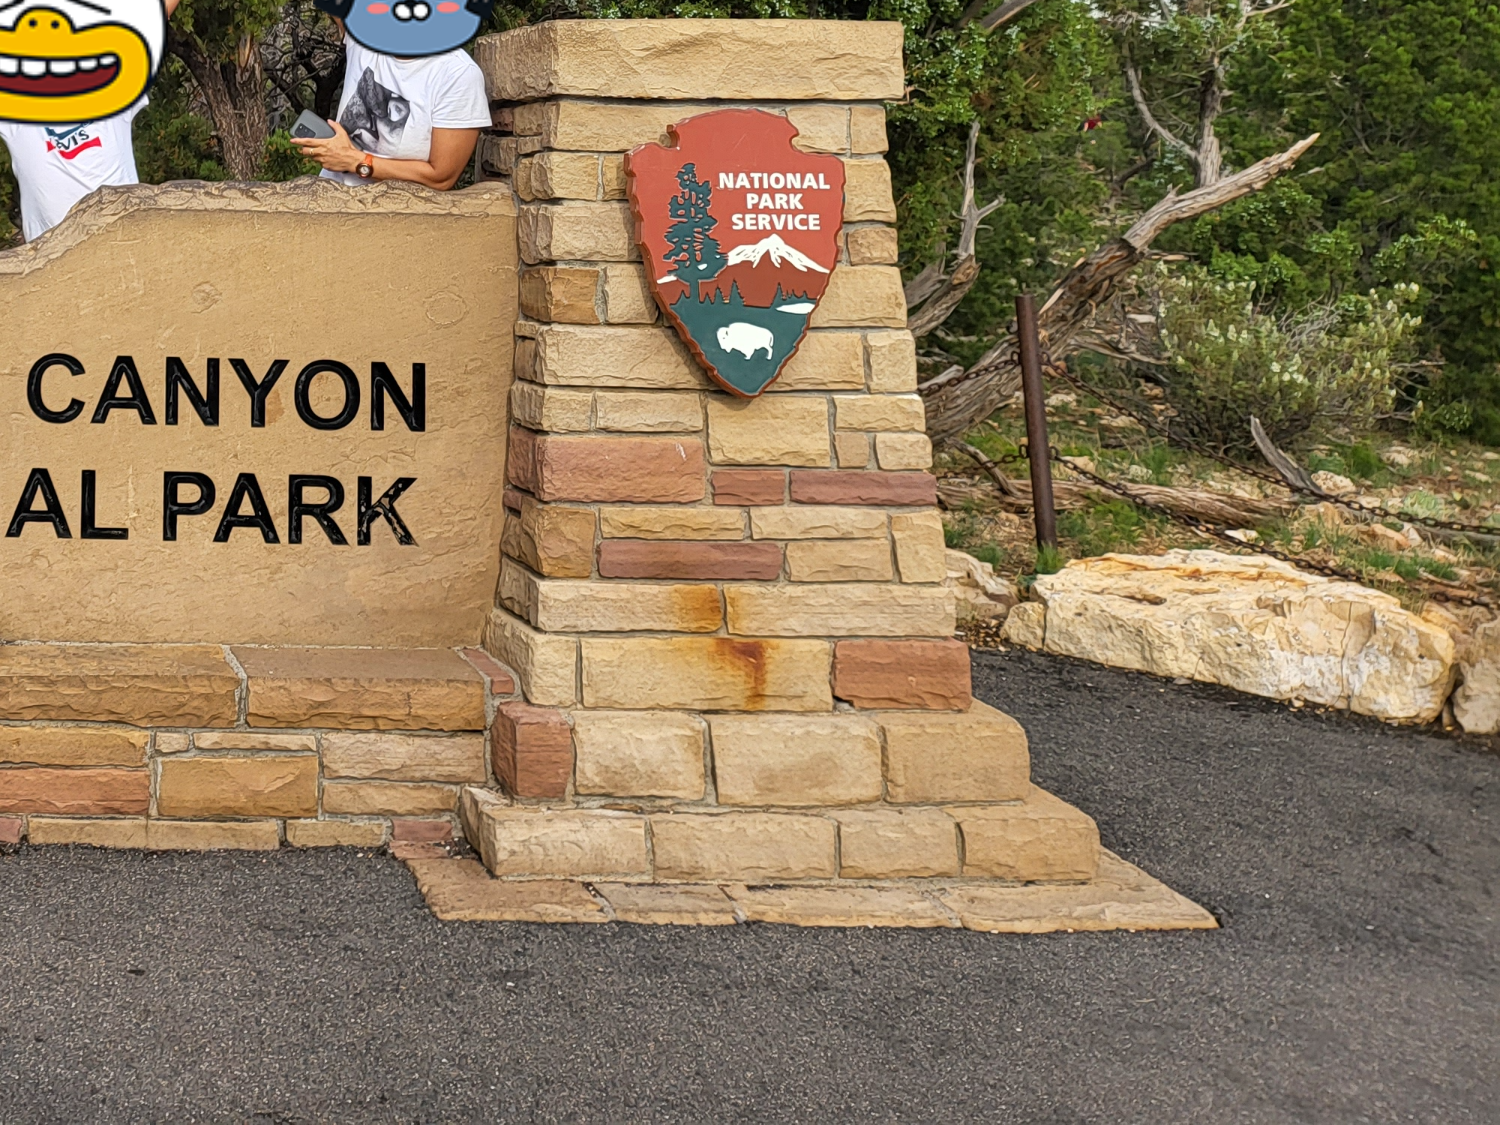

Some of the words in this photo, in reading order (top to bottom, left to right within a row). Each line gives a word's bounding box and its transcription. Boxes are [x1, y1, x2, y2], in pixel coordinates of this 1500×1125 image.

[718, 172, 831, 189] NATIONAL
[746, 192, 804, 210] PARK
[731, 213, 821, 231] SERVICE
[26, 352, 426, 433] CANYON
[162, 470, 418, 547] PARK
